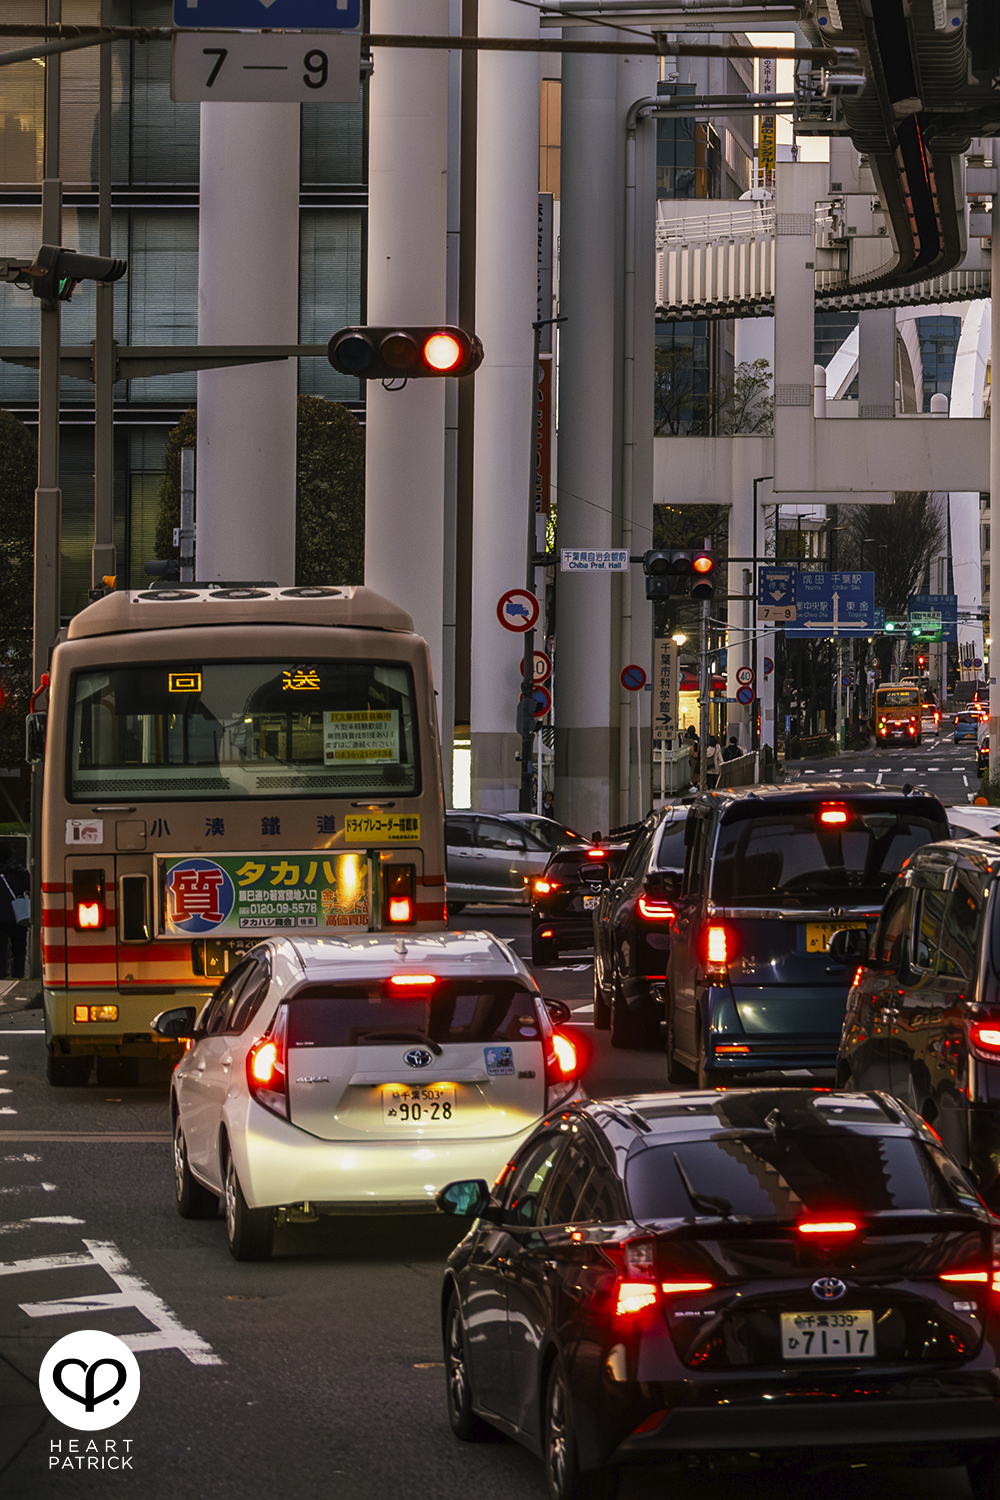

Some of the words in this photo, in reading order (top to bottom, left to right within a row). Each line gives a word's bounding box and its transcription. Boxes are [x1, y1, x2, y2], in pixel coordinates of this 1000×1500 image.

[564, 551, 627, 562] 千葉県自治会館前
[568, 561, 588, 569] Chiba
[590, 561, 607, 569] Pref.
[608, 561, 622, 569] Hall
[802, 574, 824, 584] 成田
[831, 574, 862, 584] 千葉駅
[846, 601, 869, 611] 東金
[168, 670, 321, 692] 回送
[660, 643, 671, 713] 千葉市科学館
[740, 671, 750, 680] 40
[150, 815, 337, 838] 小湊鐵道
[346, 817, 419, 833] ドライブレコーダー搭載車
[235, 860, 368, 887] タカハ
[169, 868, 224, 924] 質
[250, 903, 317, 915] 0120-09-5578
[241, 917, 292, 927] タカハシ商会
[401, 1090, 420, 1101] 千葉
[421, 1090, 440, 1100] 503
[399, 1102, 453, 1121] 90-28
[805, 1315, 830, 1328] 千葉
[831, 1313, 855, 1327] 339
[802, 1329, 870, 1355] 71-17
